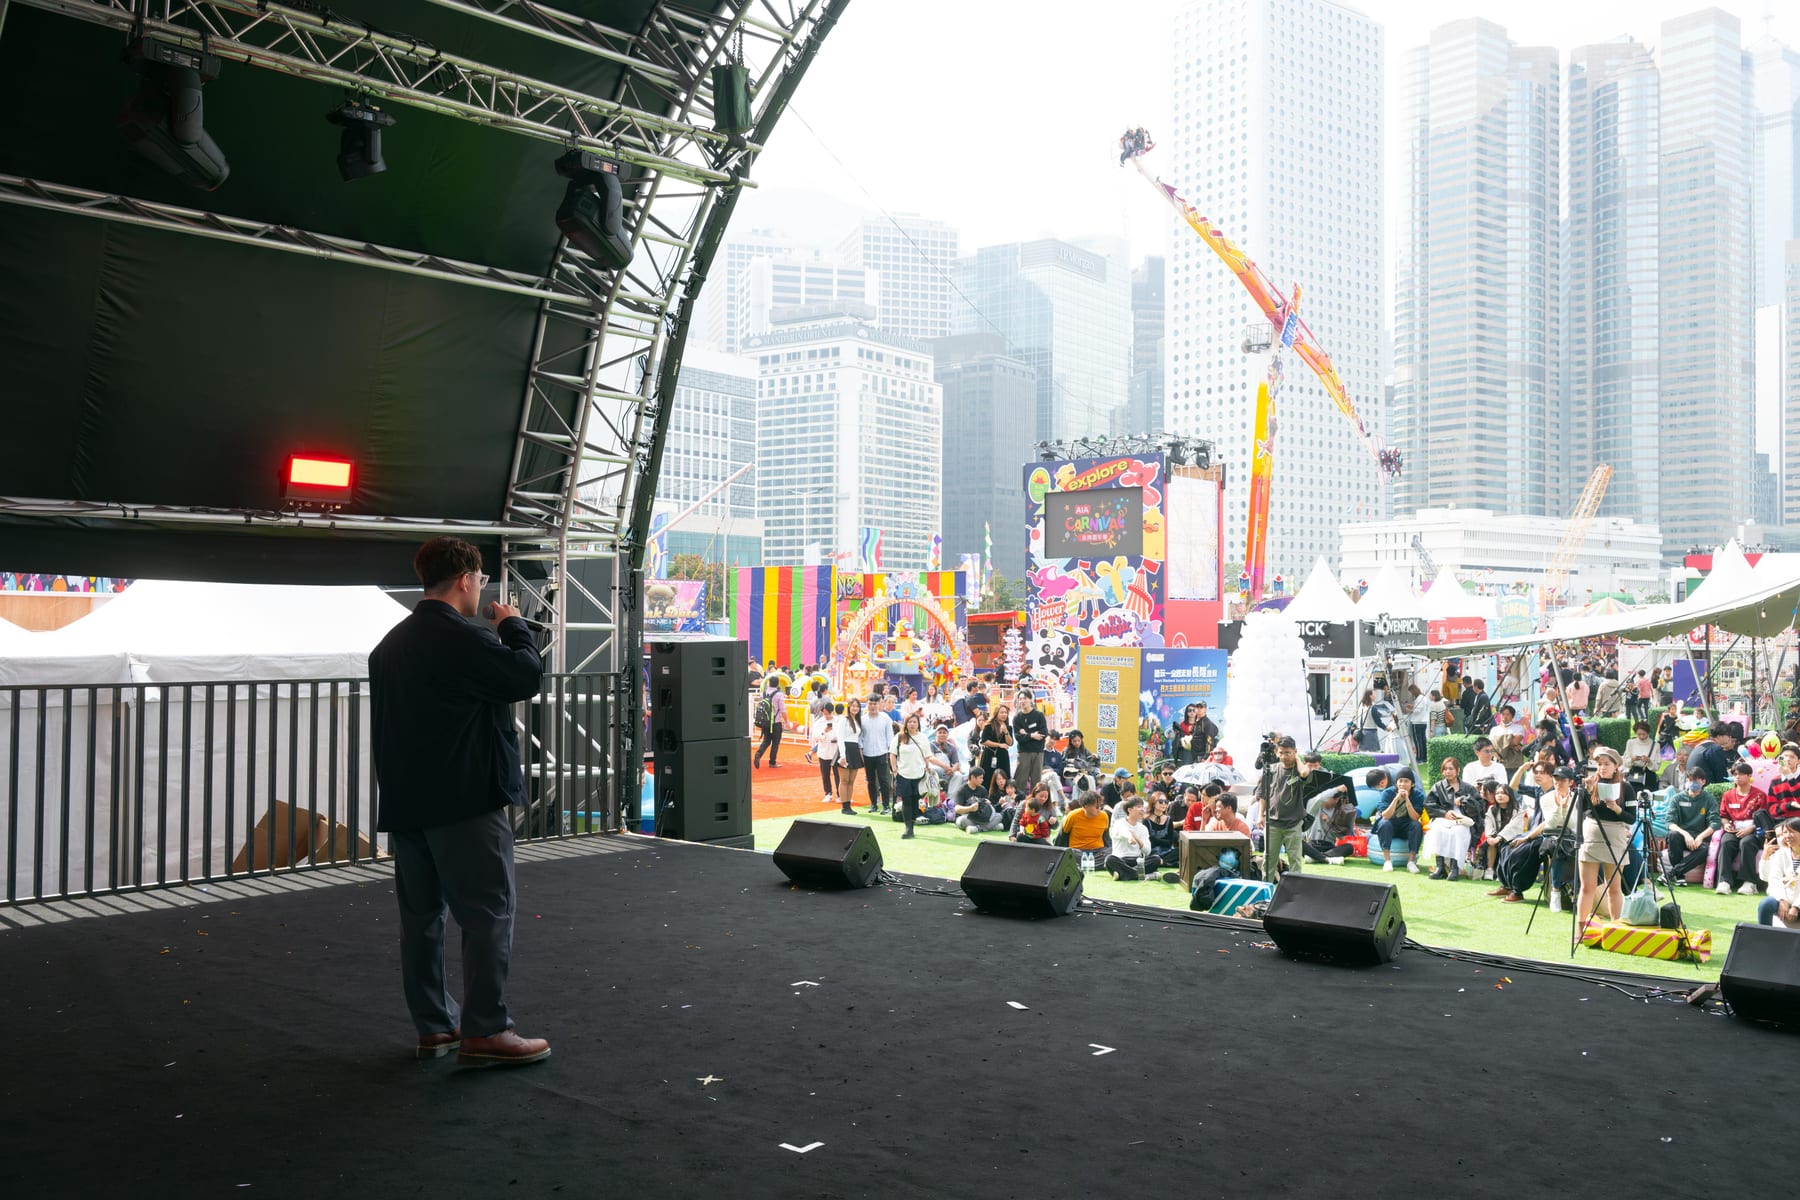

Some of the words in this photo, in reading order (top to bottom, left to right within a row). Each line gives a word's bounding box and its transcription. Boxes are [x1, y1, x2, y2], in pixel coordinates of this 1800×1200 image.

[1068, 460, 1129, 491] explore
[1075, 506, 1089, 514] AIA
[1065, 514, 1126, 532] CARNIVAL
[1033, 604, 1065, 618] Flower
[1034, 616, 1062, 630] Floer
